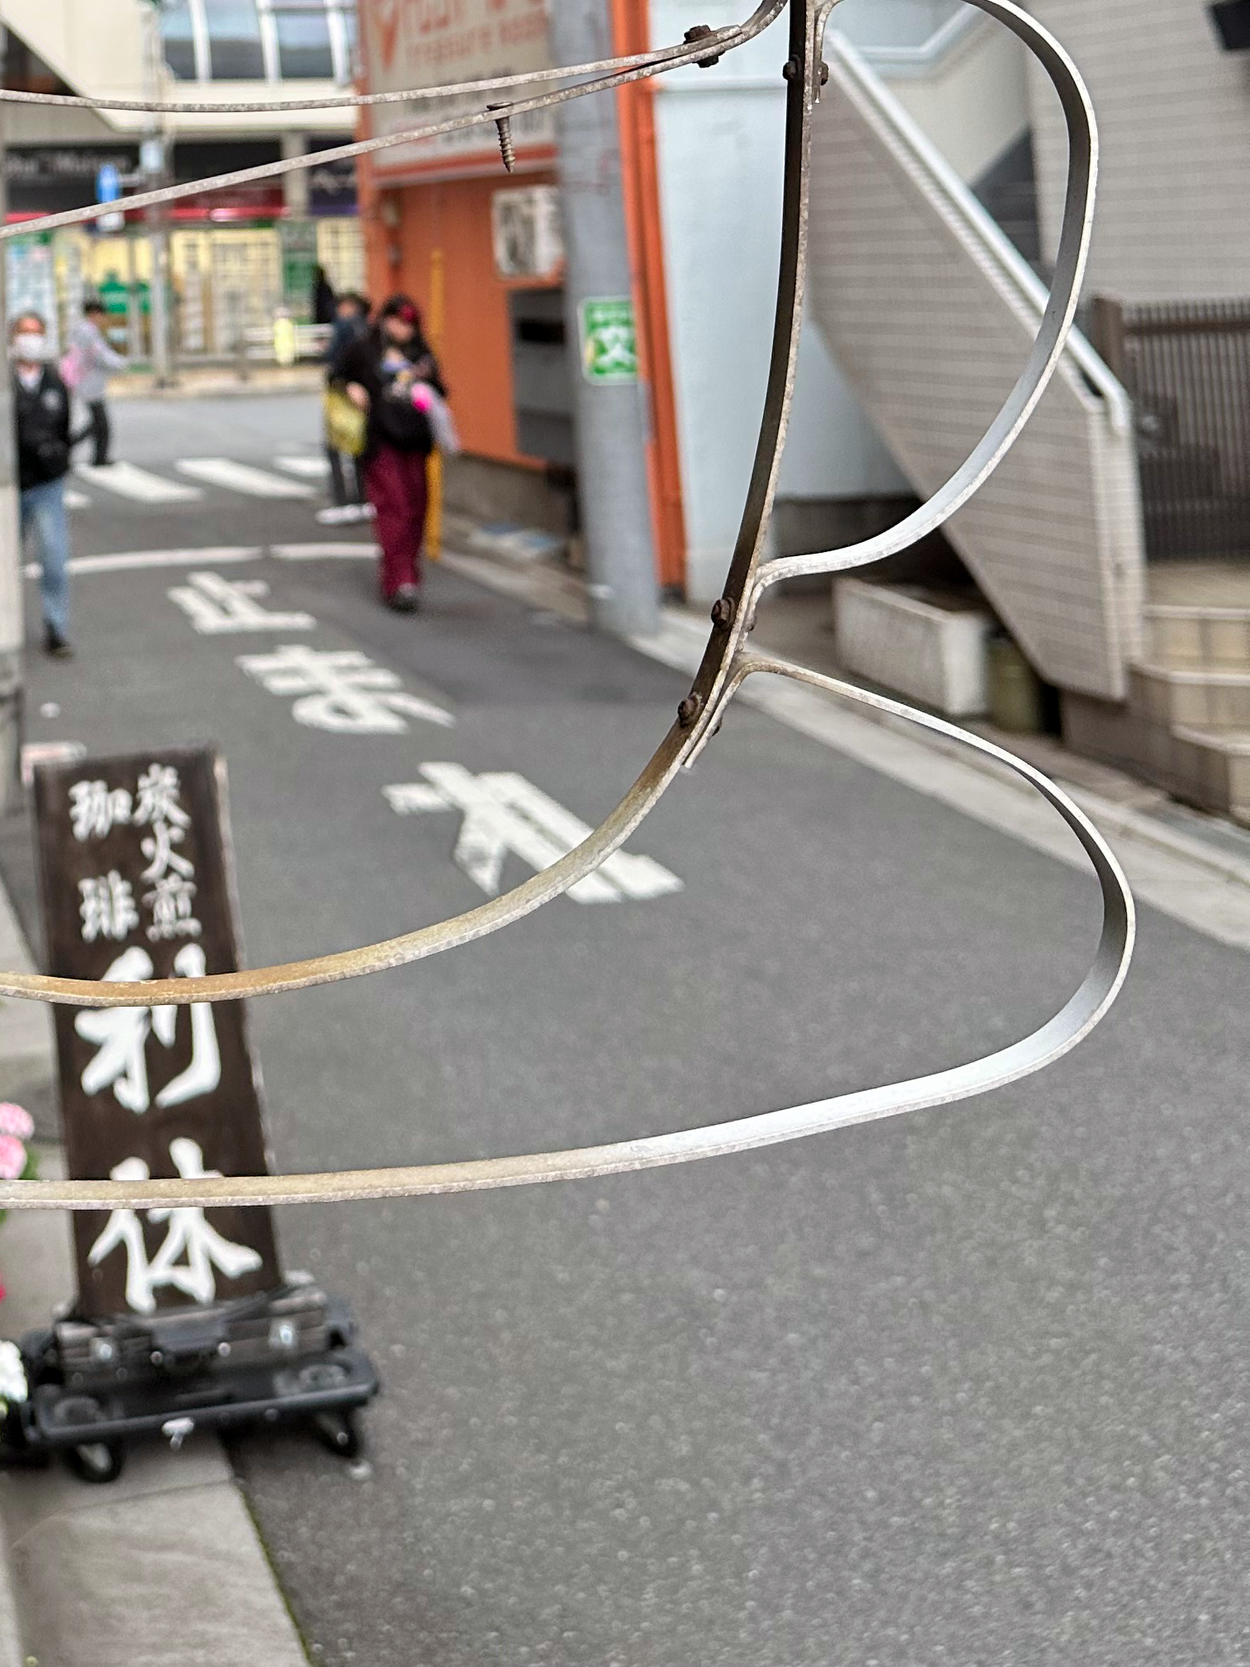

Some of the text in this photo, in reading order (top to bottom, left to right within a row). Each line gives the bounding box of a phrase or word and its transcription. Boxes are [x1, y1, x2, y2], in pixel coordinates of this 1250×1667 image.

[68, 780, 140, 942] 珈琲
[167, 571, 684, 903] 止まれ
[74, 943, 263, 1313] 利休
